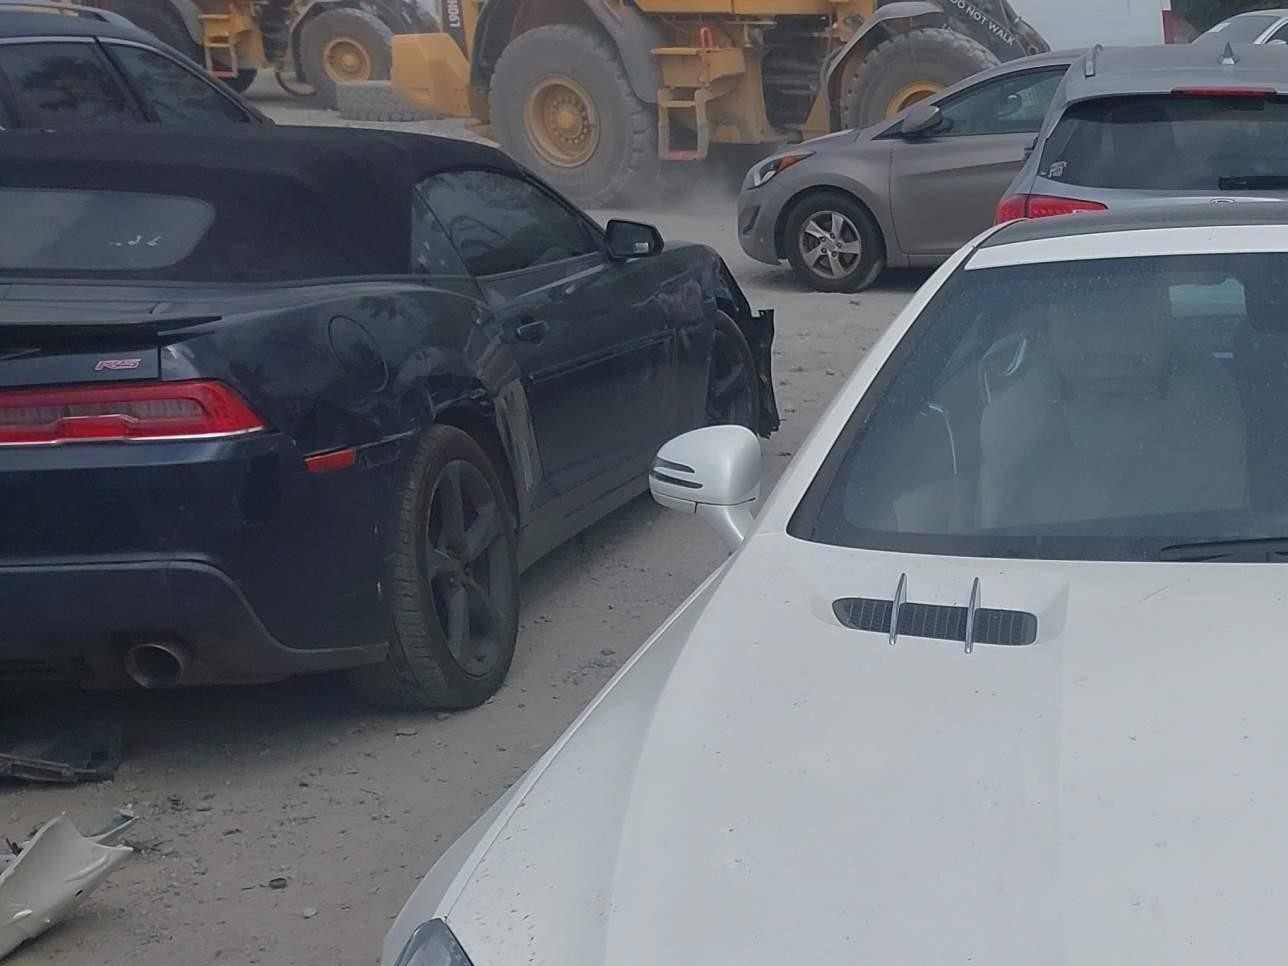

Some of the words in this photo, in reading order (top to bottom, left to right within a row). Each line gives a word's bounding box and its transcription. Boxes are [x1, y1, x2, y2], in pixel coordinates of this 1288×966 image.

[966, 6, 987, 25] NOT
[988, 21, 1017, 47] WALK
[94, 359, 141, 371] RS
